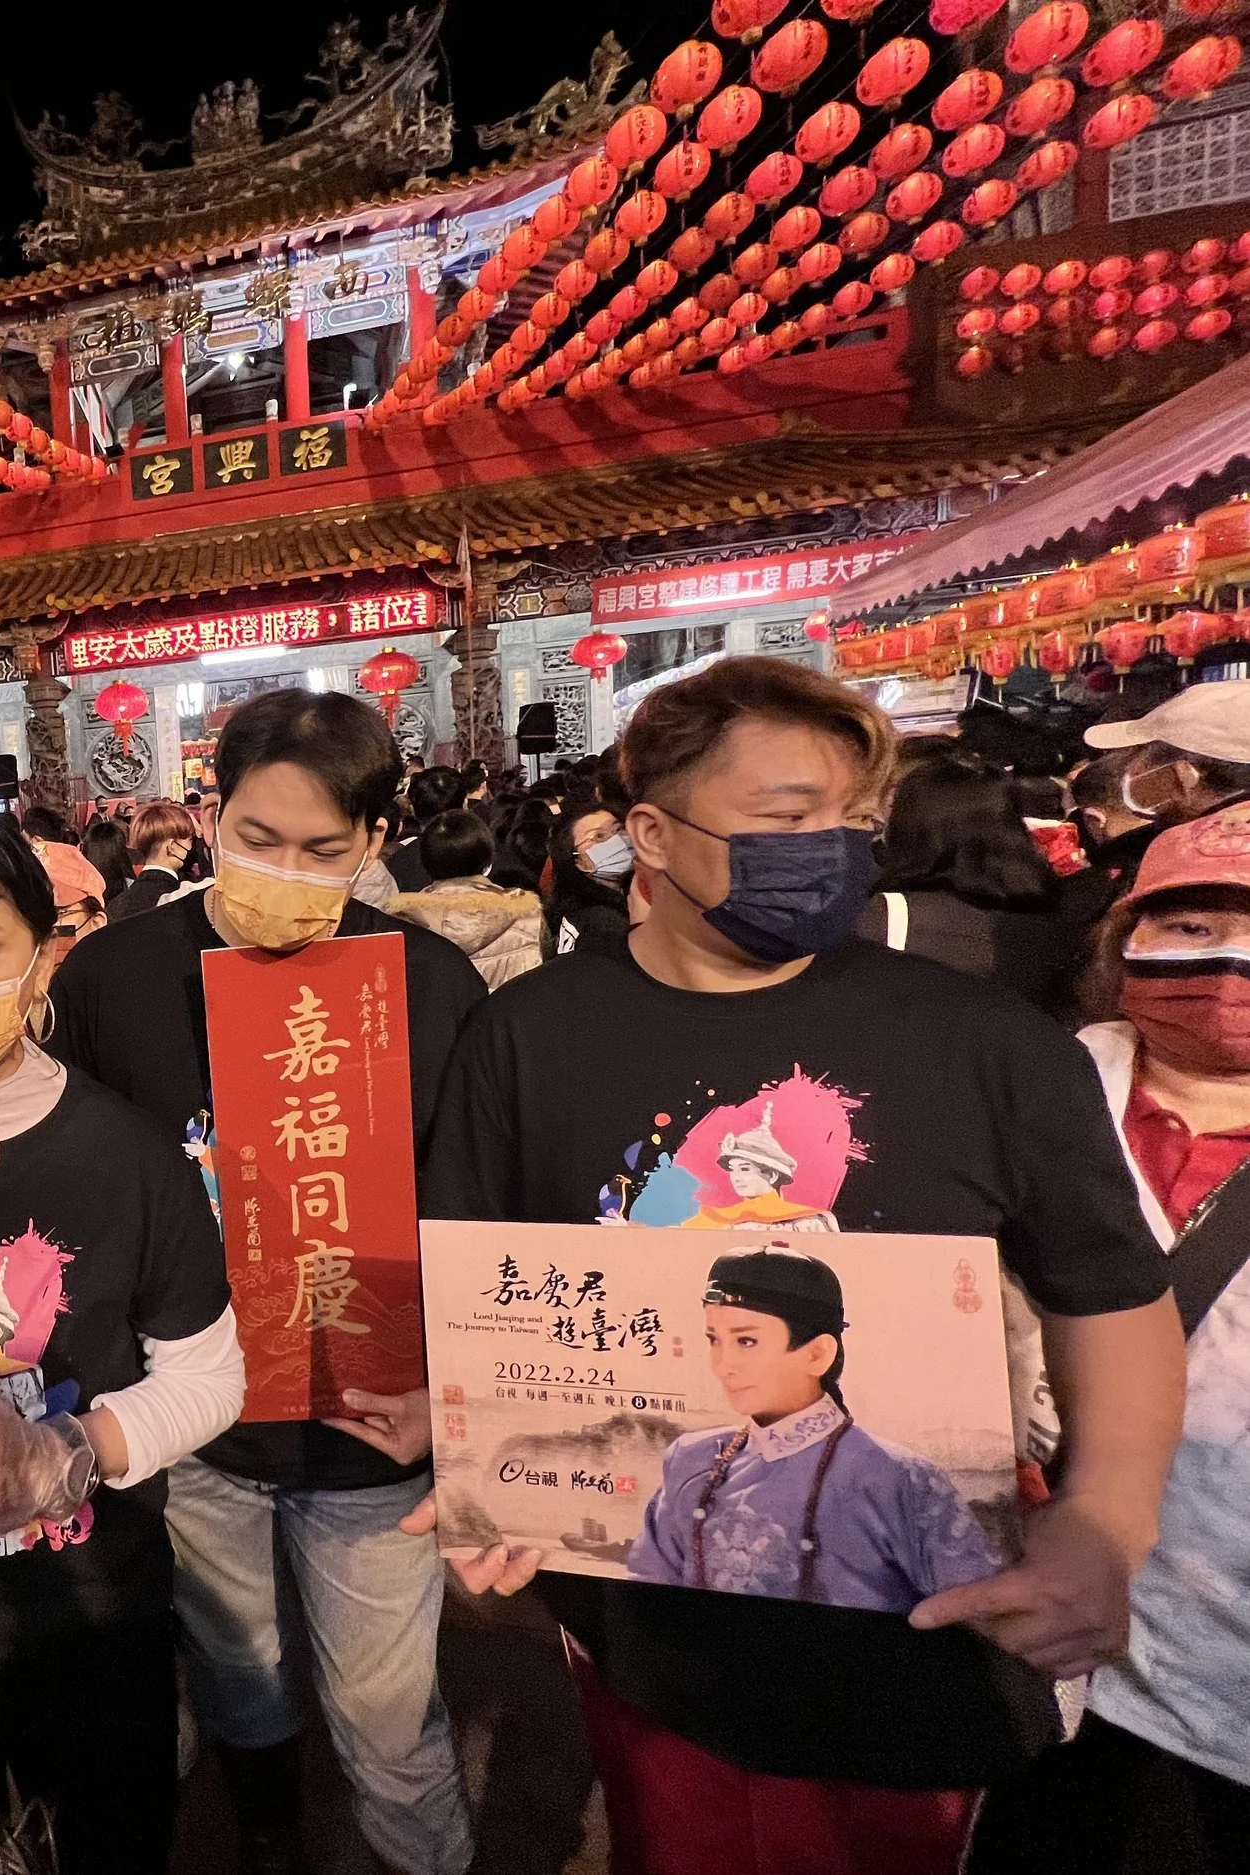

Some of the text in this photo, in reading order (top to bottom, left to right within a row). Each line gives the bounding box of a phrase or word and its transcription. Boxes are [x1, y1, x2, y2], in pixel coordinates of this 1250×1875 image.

[142, 427, 332, 497] 福興宮
[262, 984, 372, 1335] 嘉福同慶
[479, 1253, 608, 1310] 嘉慶君
[445, 1321, 540, 1335] The Journey to Taiwan
[472, 1312, 543, 1324] Lord Jiaqing and
[545, 1307, 665, 1358] 遊臺灣
[494, 1361, 616, 1387] 2022.2.24
[495, 1387, 518, 1399] 台視
[525, 1389, 597, 1406] 每週一至週五
[523, 1469, 559, 1489] 台視
